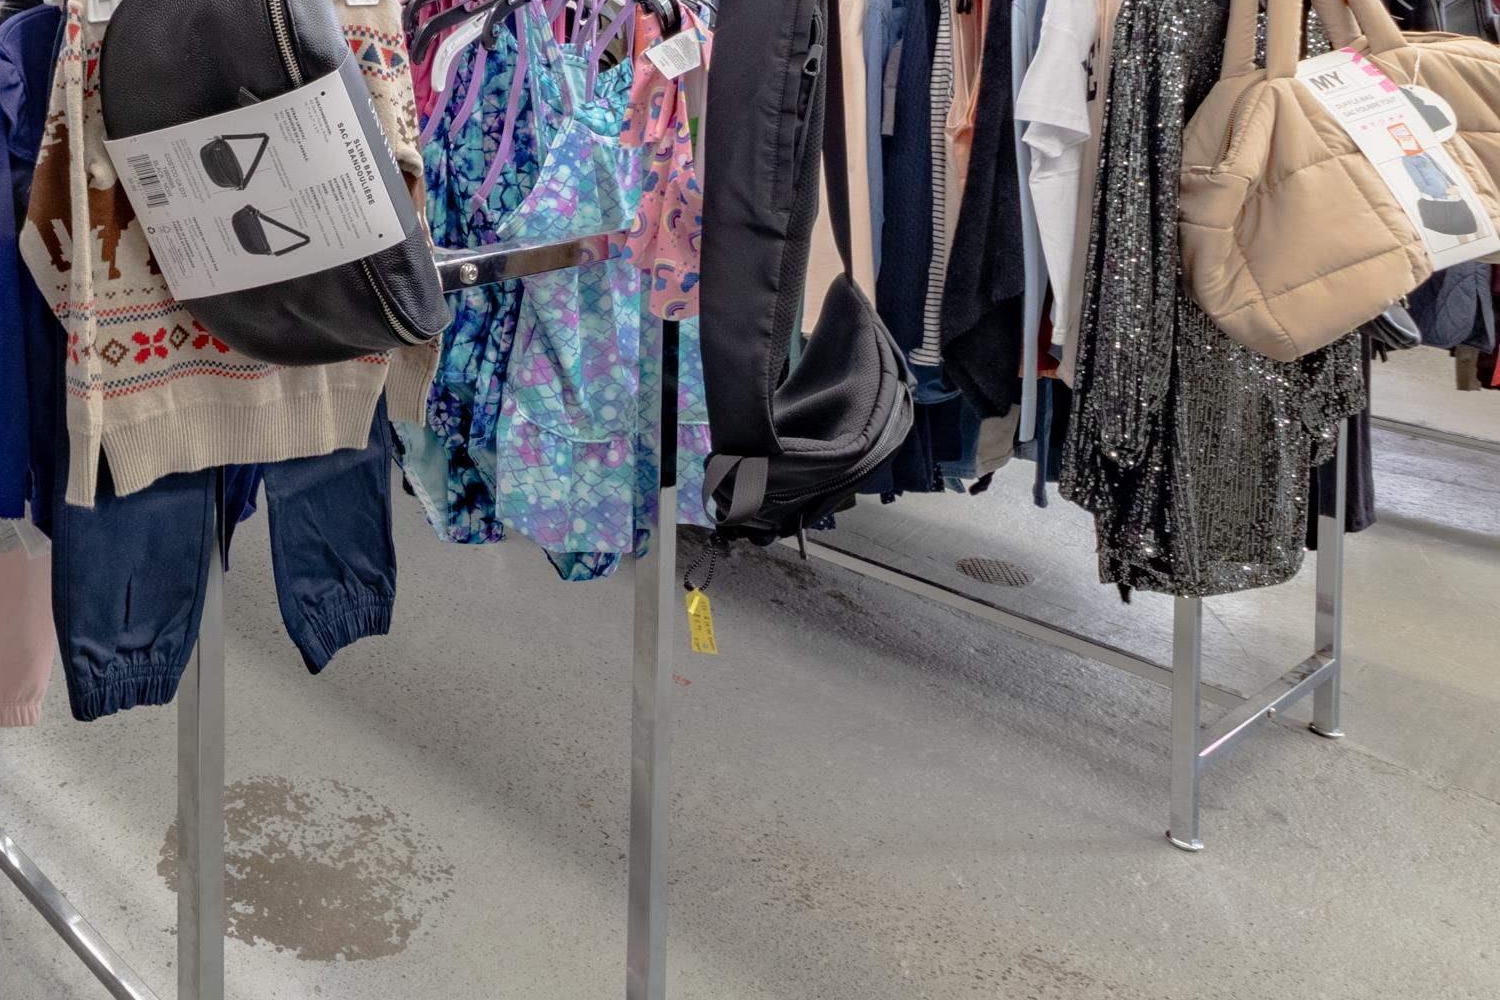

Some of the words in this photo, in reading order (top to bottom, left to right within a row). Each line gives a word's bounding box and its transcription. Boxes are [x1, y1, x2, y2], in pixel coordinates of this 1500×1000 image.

[1308, 70, 1346, 91] MY
[335, 121, 349, 140] SAC
[163, 152, 179, 178] COSTCO
[352, 137, 368, 163] SLING
[362, 163, 376, 181] BAG
